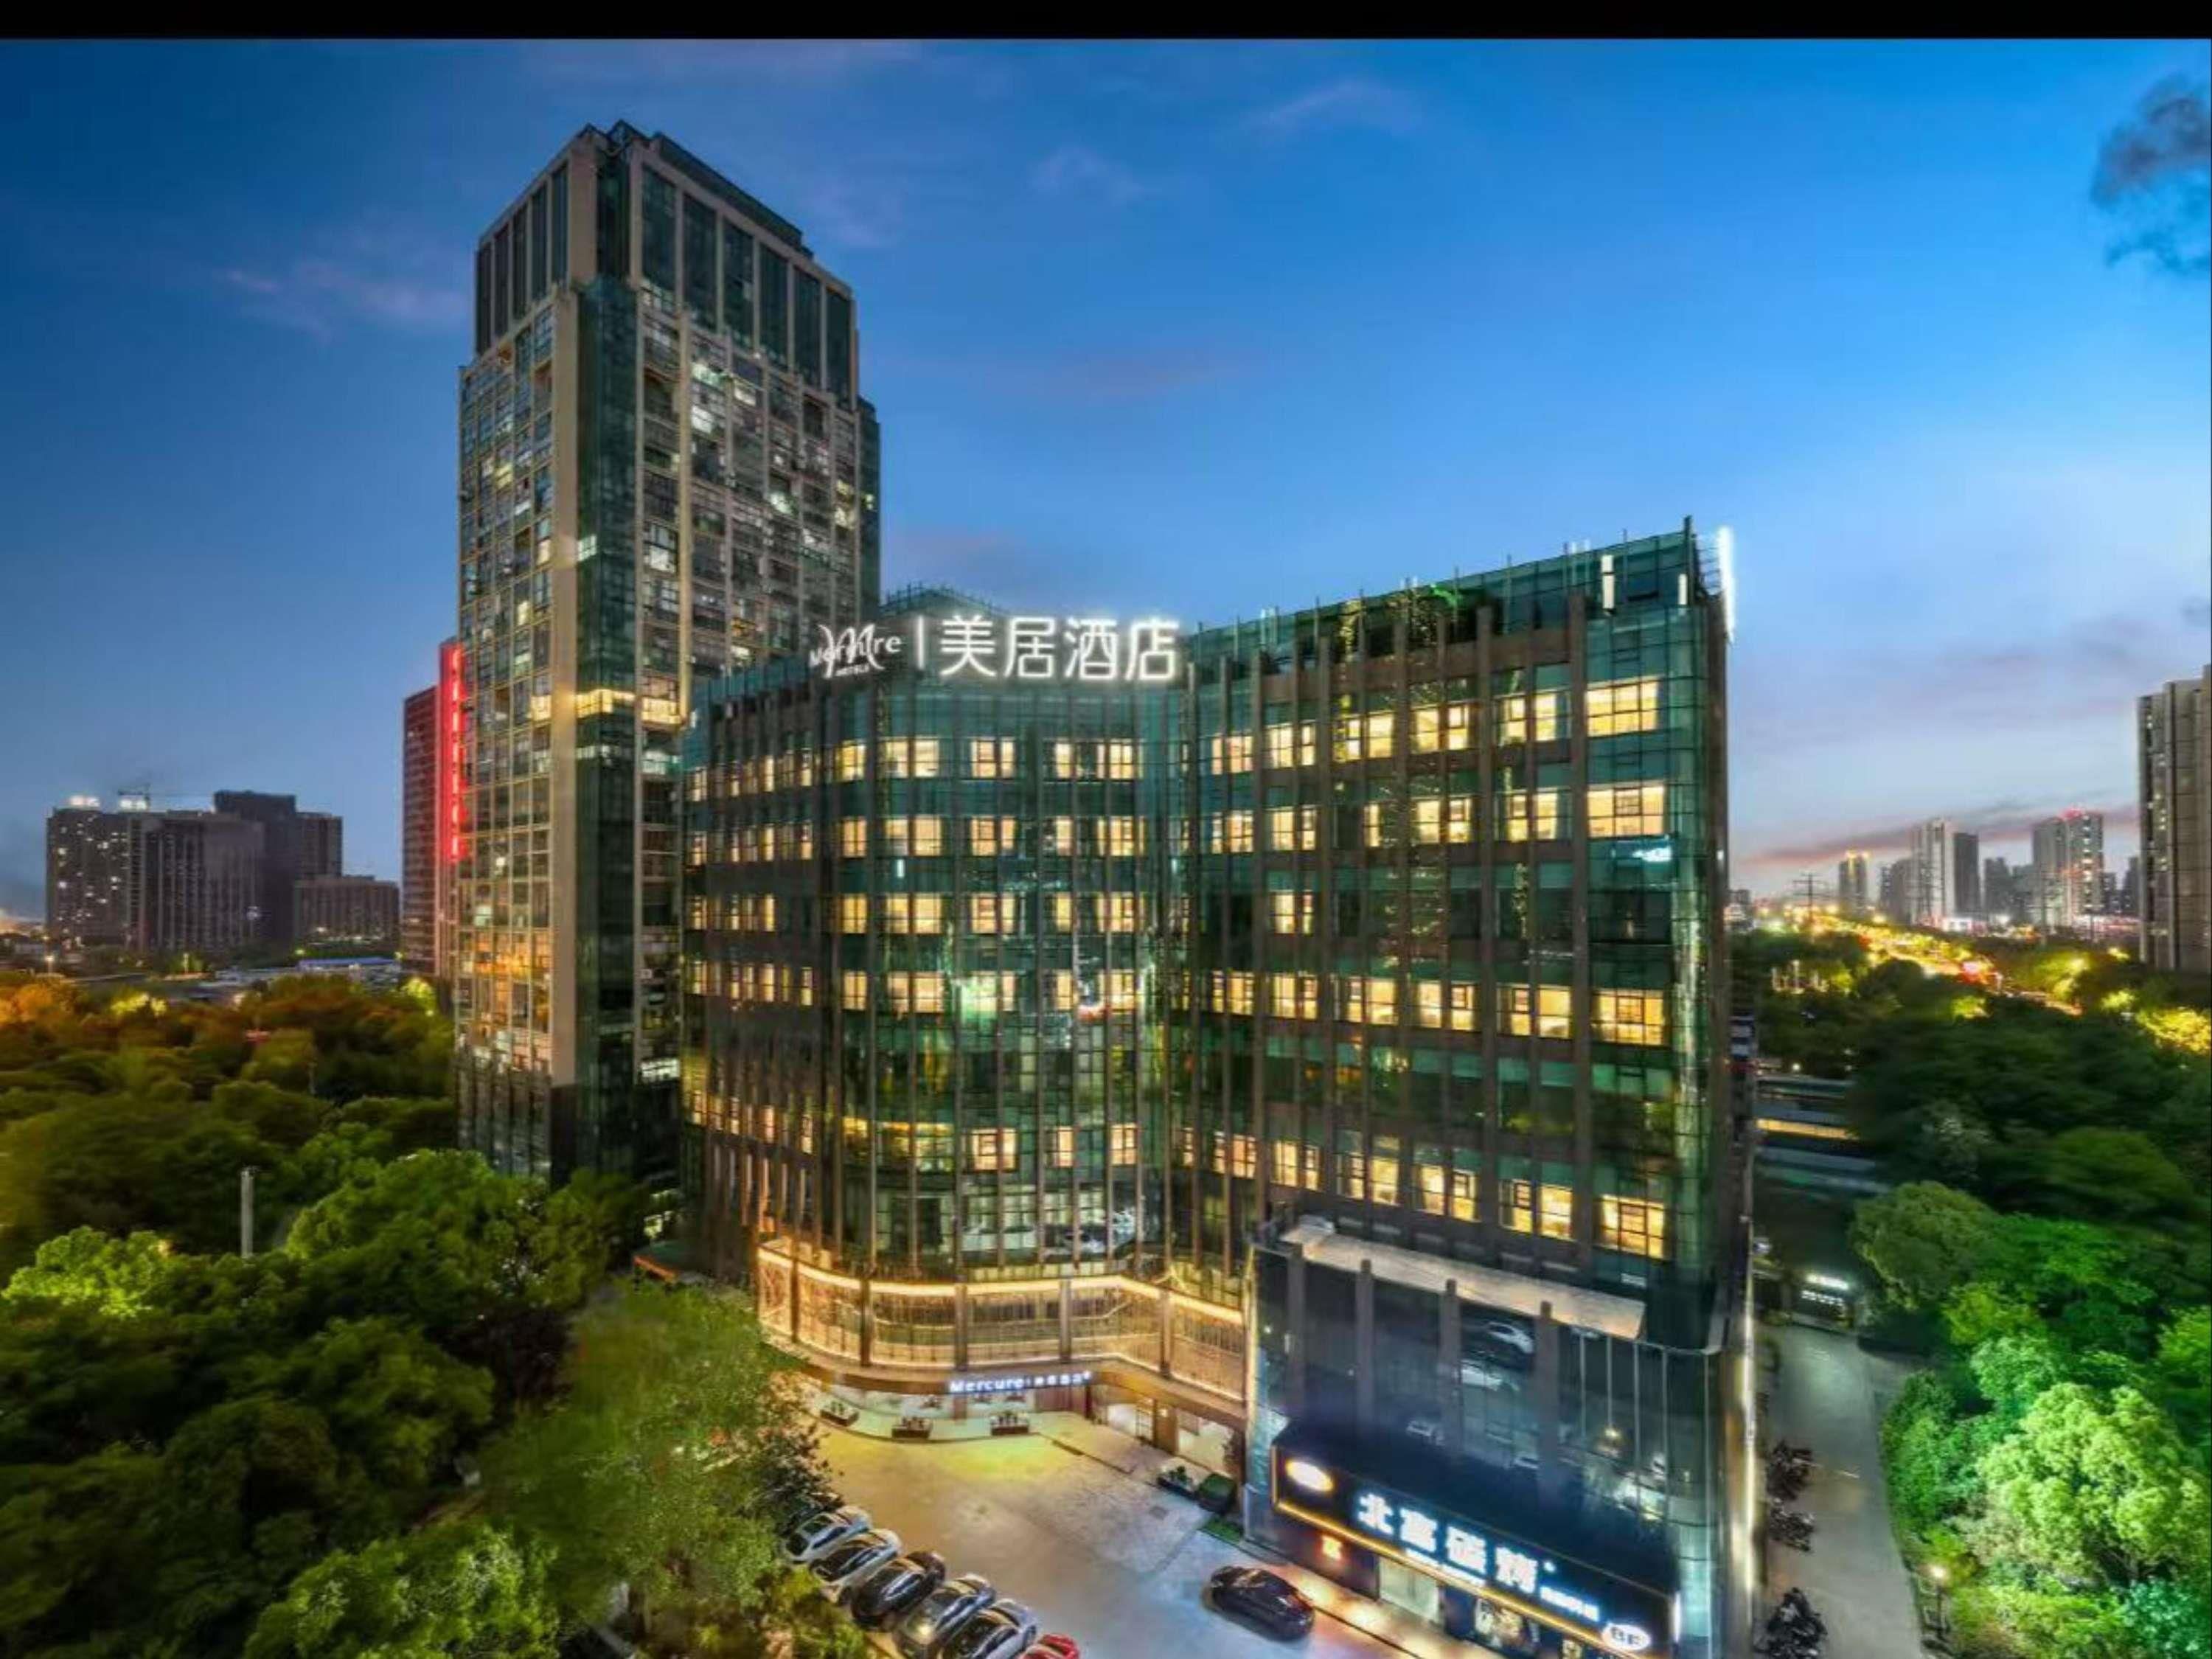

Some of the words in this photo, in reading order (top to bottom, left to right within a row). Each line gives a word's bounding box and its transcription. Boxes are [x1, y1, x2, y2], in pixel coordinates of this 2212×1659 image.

[939, 615, 1180, 681] 美居酒店
[949, 1378, 1025, 1392] Mercure
